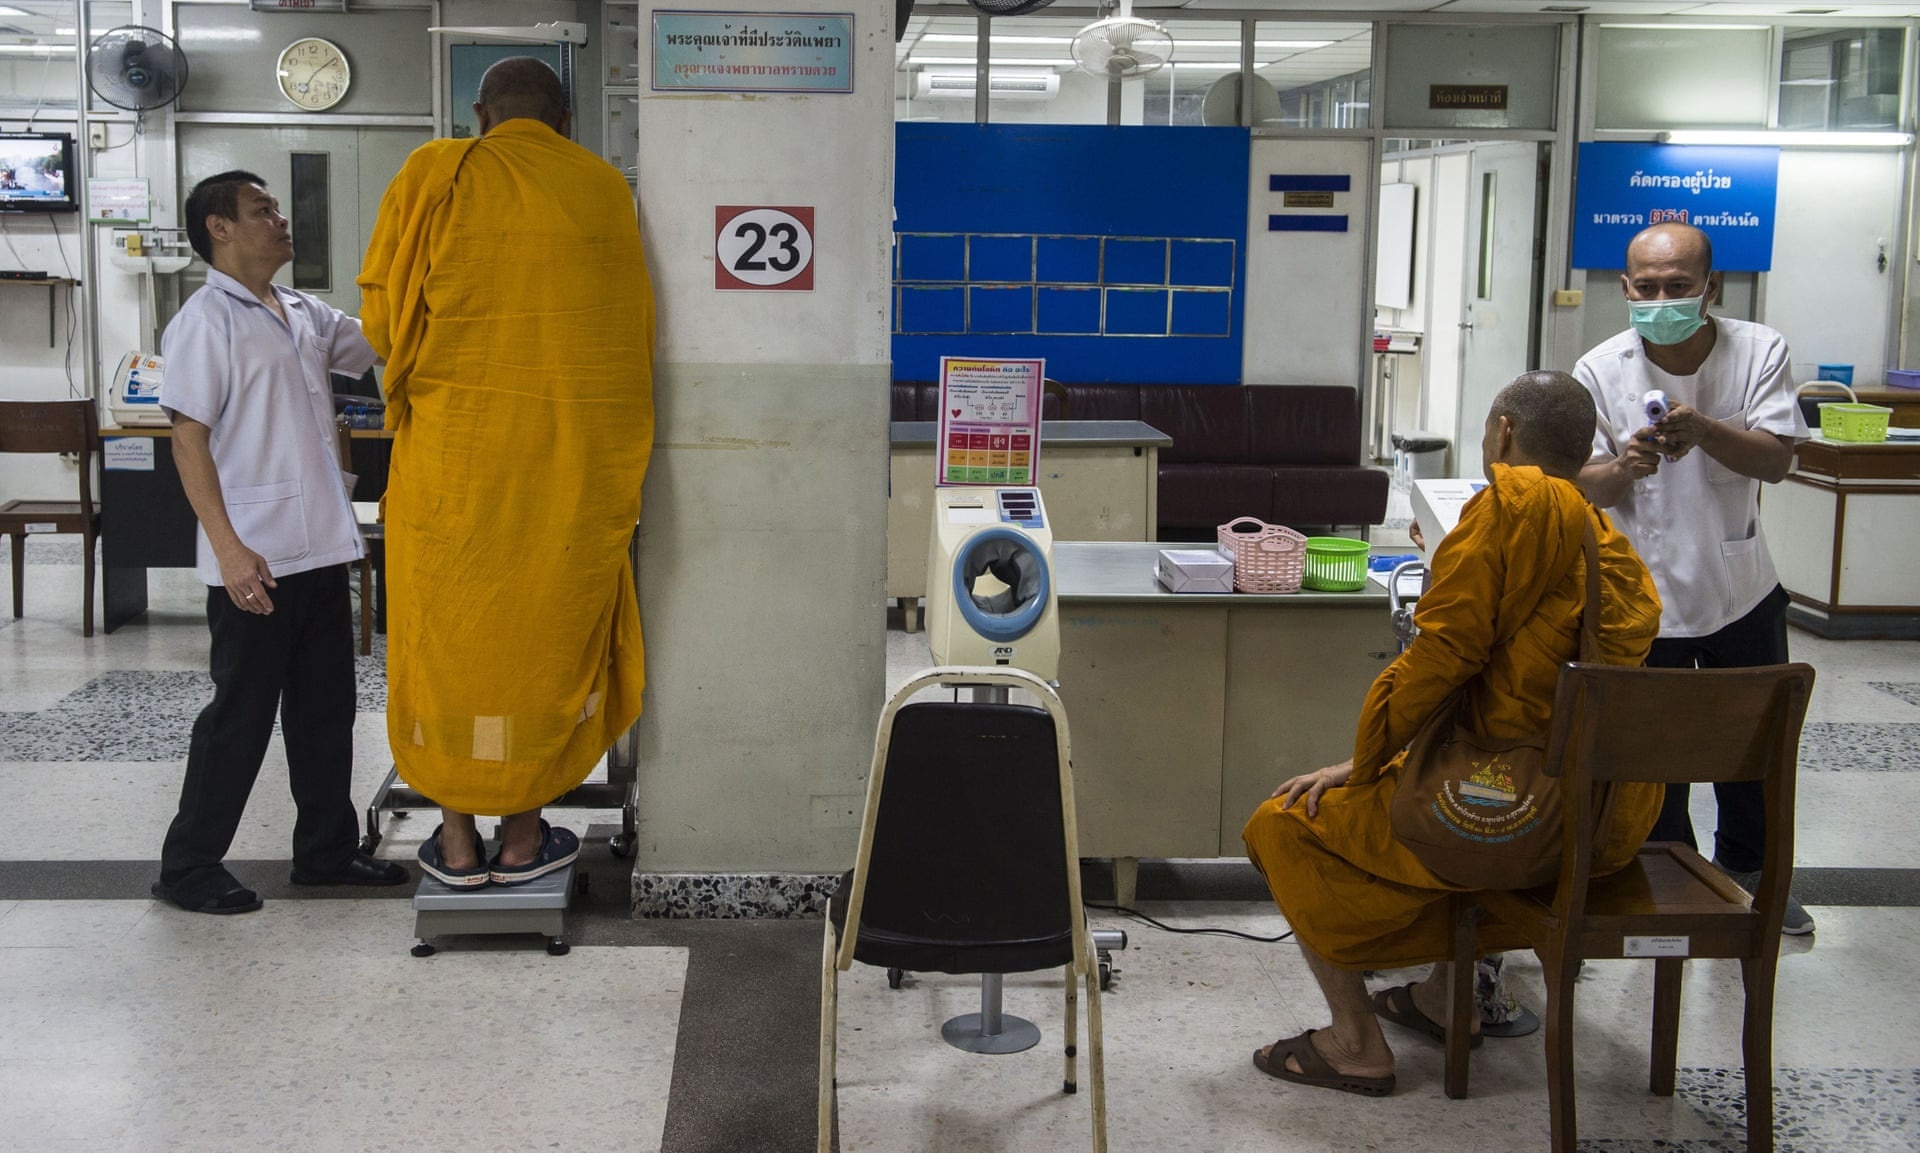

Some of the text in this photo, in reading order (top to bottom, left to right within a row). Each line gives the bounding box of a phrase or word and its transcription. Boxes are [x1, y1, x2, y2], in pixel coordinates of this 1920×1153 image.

[666, 24, 841, 52] พระคุณเจ้าที่มีประวัติแพ้ยา
[674, 55, 836, 78] กรุณาแจ้งพยาบาลทราบด้วย
[1630, 169, 1731, 194] คัดกรองผู้ป่วย
[1593, 209, 1760, 226] มาตรวจ ตรง ตามวันนัด
[733, 222, 801, 272] 23
